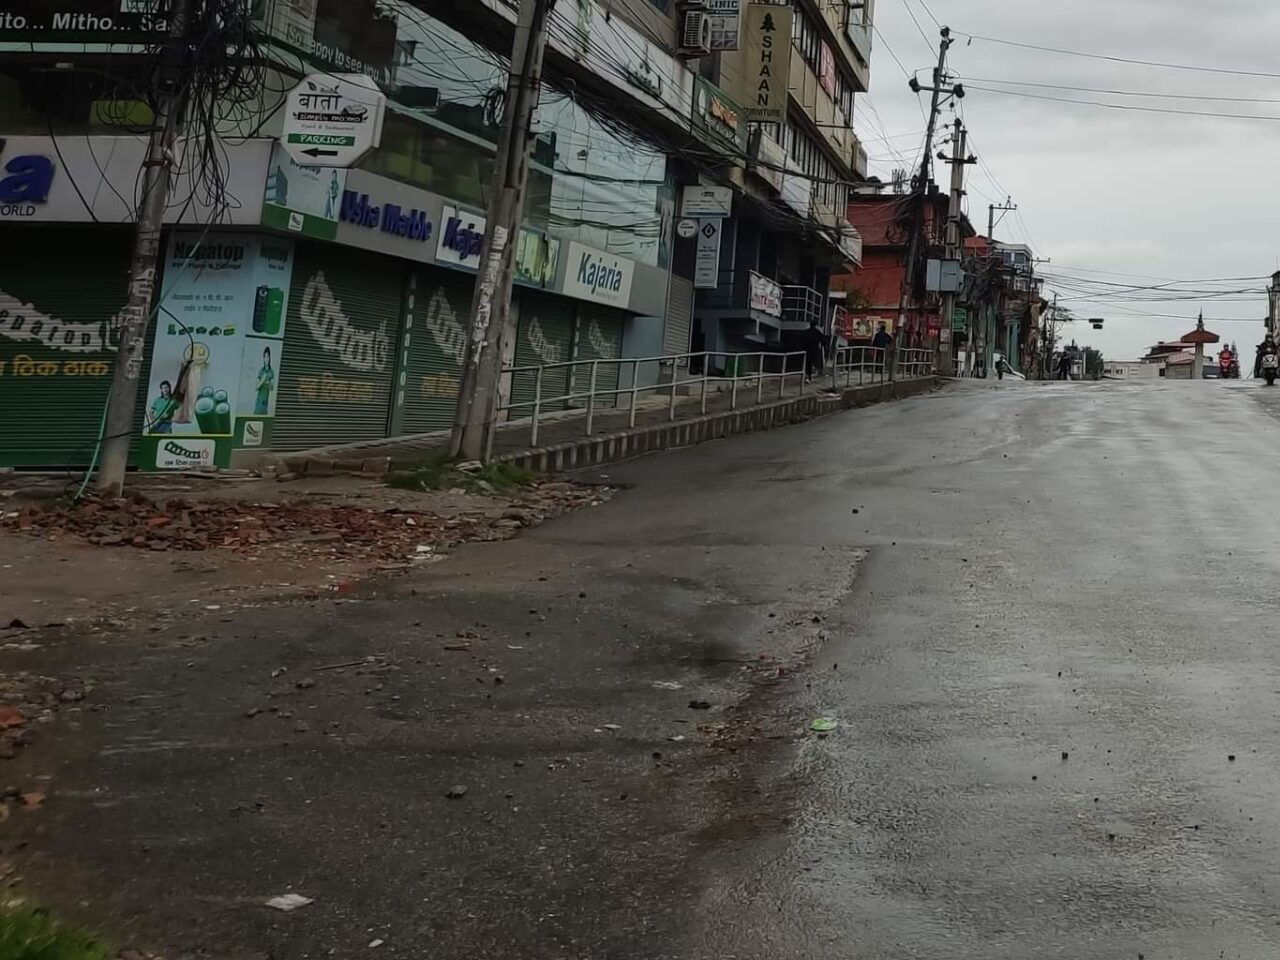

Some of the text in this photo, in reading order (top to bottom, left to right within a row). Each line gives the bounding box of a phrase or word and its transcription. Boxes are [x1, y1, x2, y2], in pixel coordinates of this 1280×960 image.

[708, 0, 739, 9] LINIC
[335, 47, 345, 66] to
[345, 55, 363, 72] see
[299, 134, 347, 145] PARKING
[381, 203, 433, 242] Marble
[576, 251, 622, 295] Kajaria
